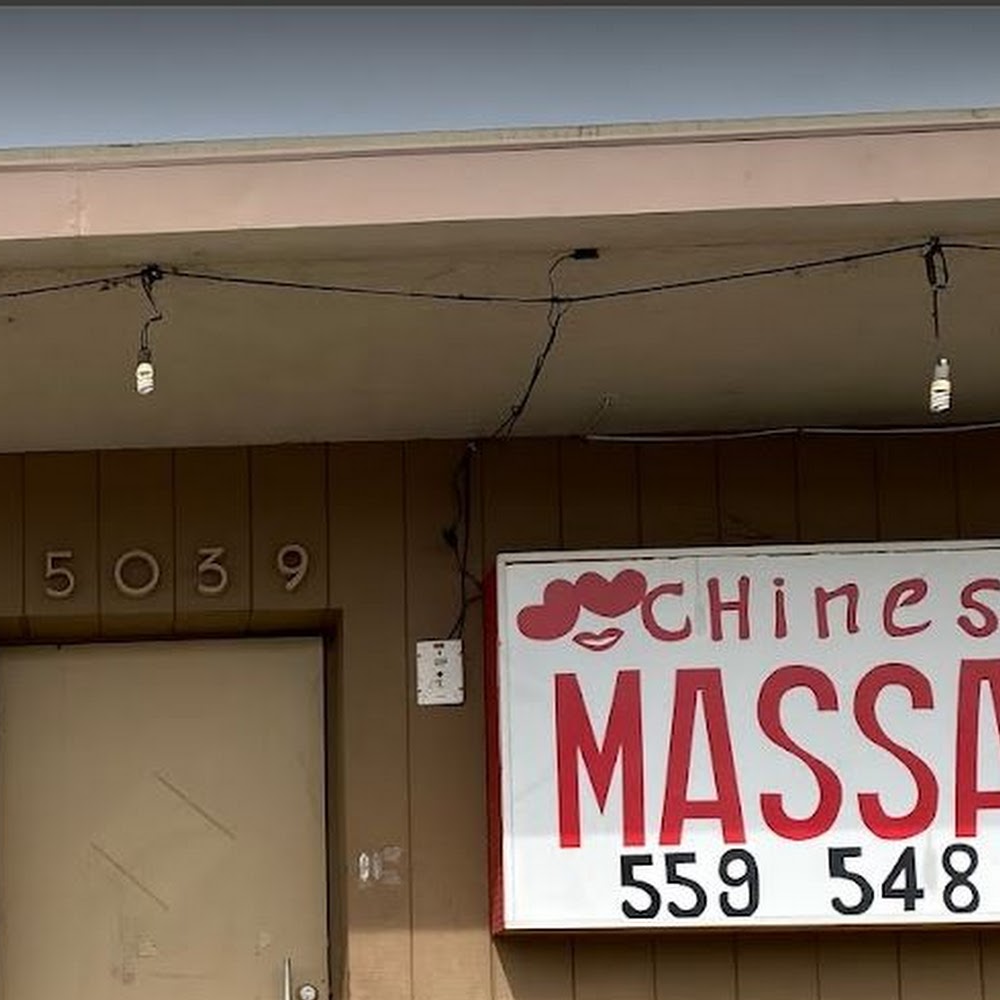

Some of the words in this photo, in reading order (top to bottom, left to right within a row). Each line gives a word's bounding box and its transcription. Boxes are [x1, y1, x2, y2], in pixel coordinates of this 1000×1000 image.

[46, 545, 308, 597] 5039
[554, 659, 1000, 849] MASSA
[619, 848, 760, 920] 559
[827, 843, 980, 915] 548
